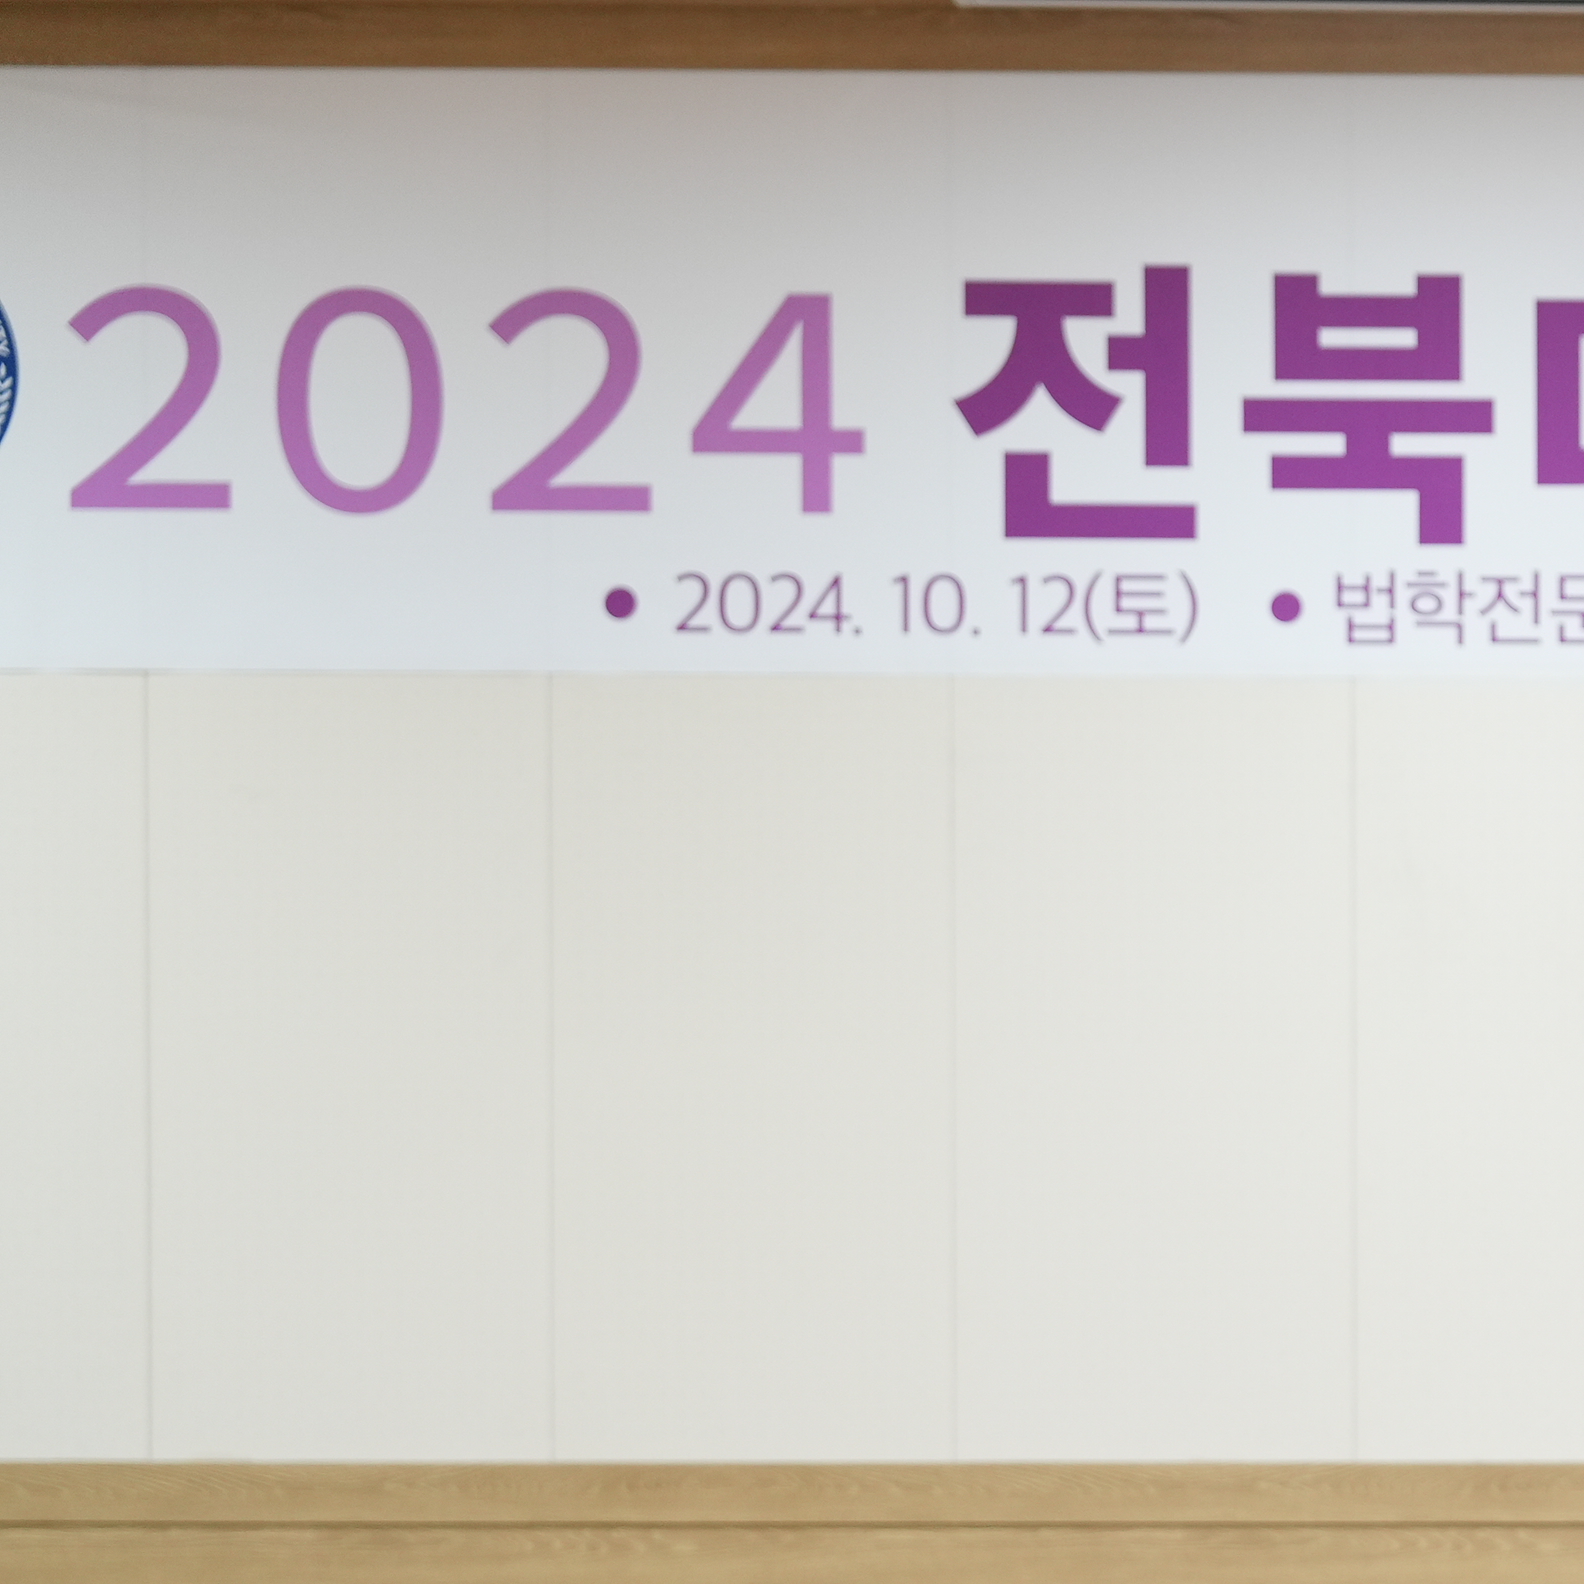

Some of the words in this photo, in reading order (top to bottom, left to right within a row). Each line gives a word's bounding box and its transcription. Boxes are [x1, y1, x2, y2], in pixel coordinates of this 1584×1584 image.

[67, 285, 866, 515] 2024
[674, 572, 864, 636] 2024.
[892, 573, 980, 636] 10.
[1010, 570, 1199, 642] 12(토)
